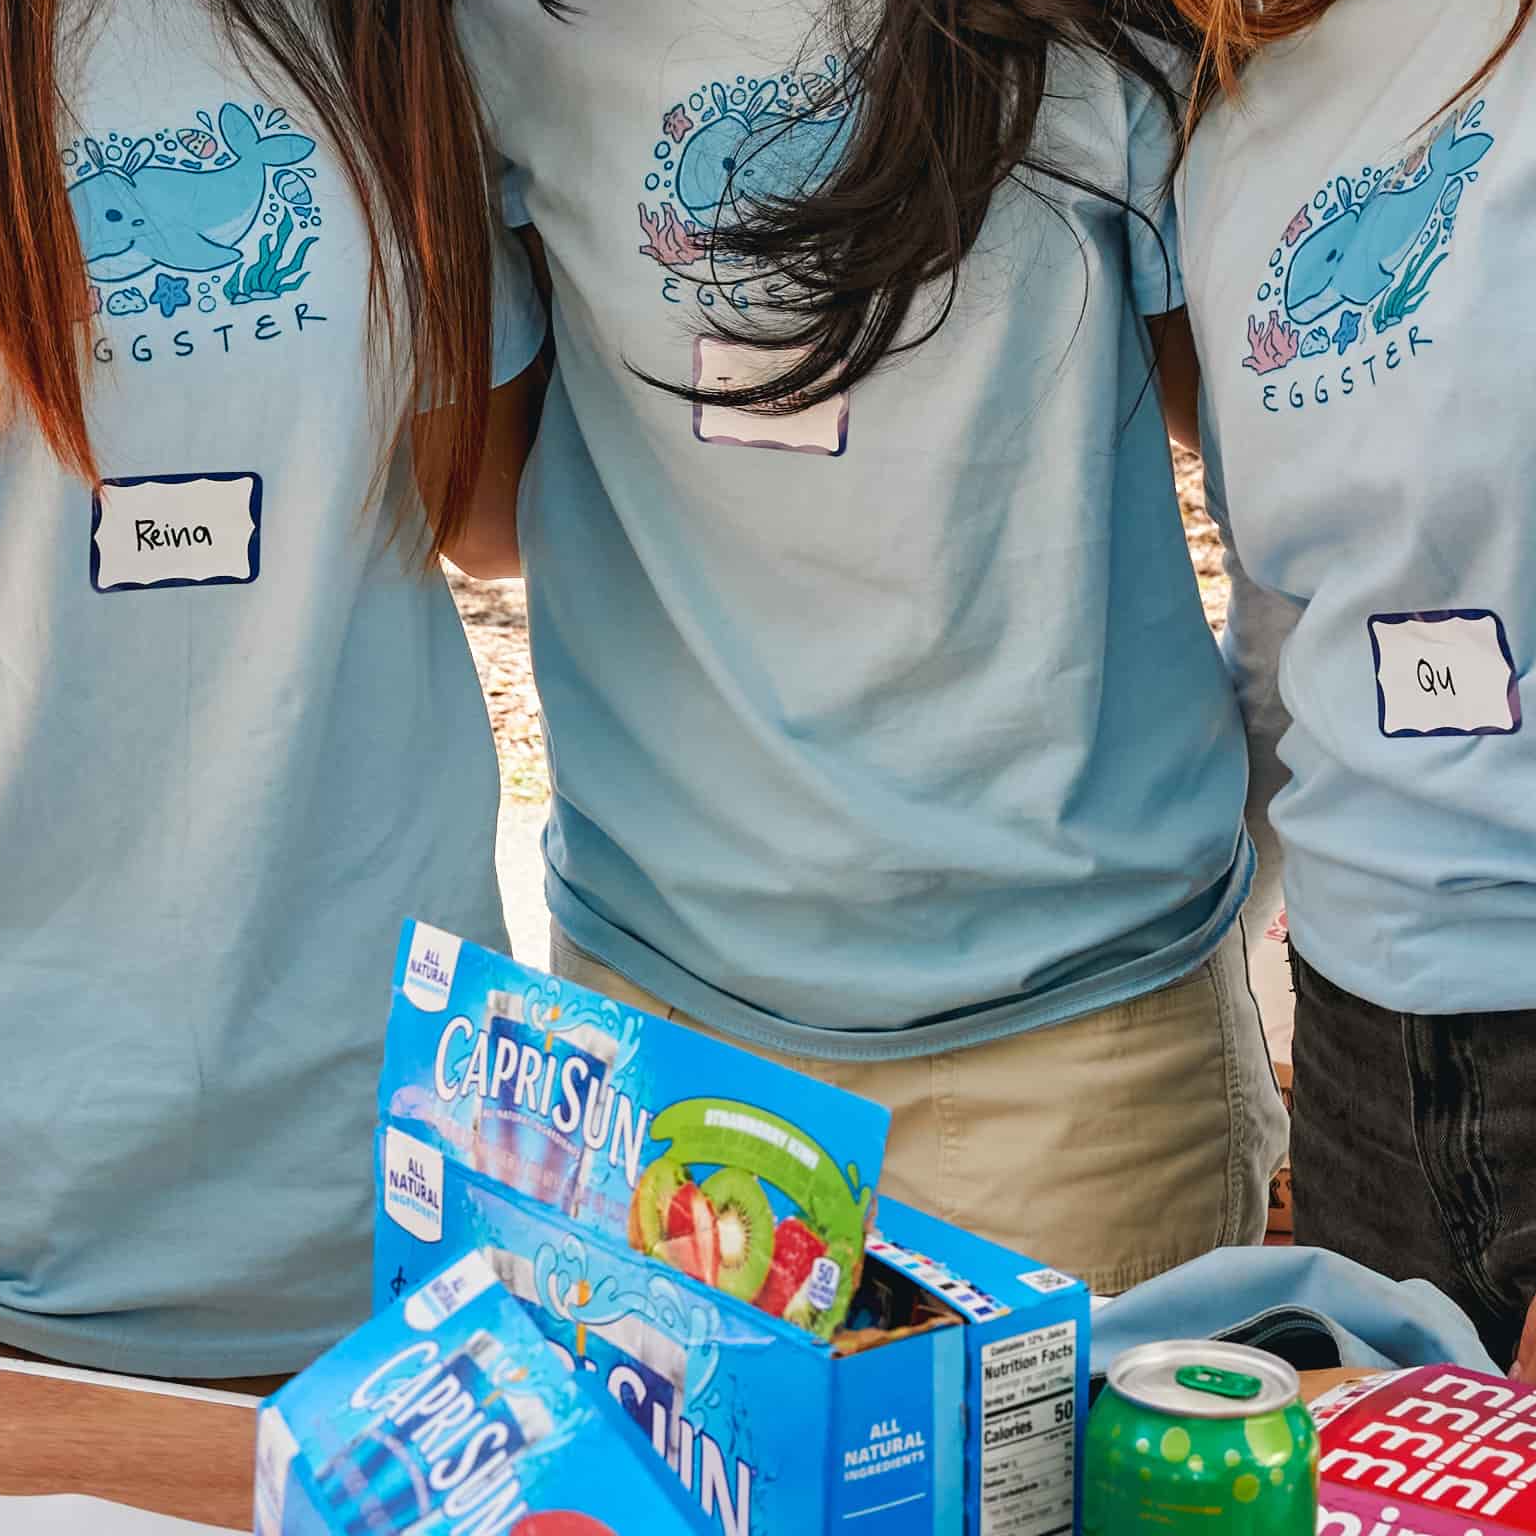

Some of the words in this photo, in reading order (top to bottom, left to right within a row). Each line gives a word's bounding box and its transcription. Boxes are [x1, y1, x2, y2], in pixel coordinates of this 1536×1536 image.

[93, 302, 327, 363] GGSTER
[1262, 326, 1433, 412] EGGSTER
[135, 519, 213, 552] Reina
[410, 959, 449, 987] NATURAL
[424, 948, 440, 966] ALL
[408, 1157, 426, 1182] ALL
[389, 1169, 440, 1209] NATURAL
[817, 1262, 834, 1284] 50
[984, 1355, 1038, 1380] Nutrition
[1041, 1344, 1073, 1362] Facts
[869, 1417, 901, 1441] ALL
[984, 1420, 1033, 1445] Calories
[1054, 1399, 1073, 1423] 50
[844, 1431, 926, 1467] NATURAL
[1318, 1448, 1529, 1516] mini
